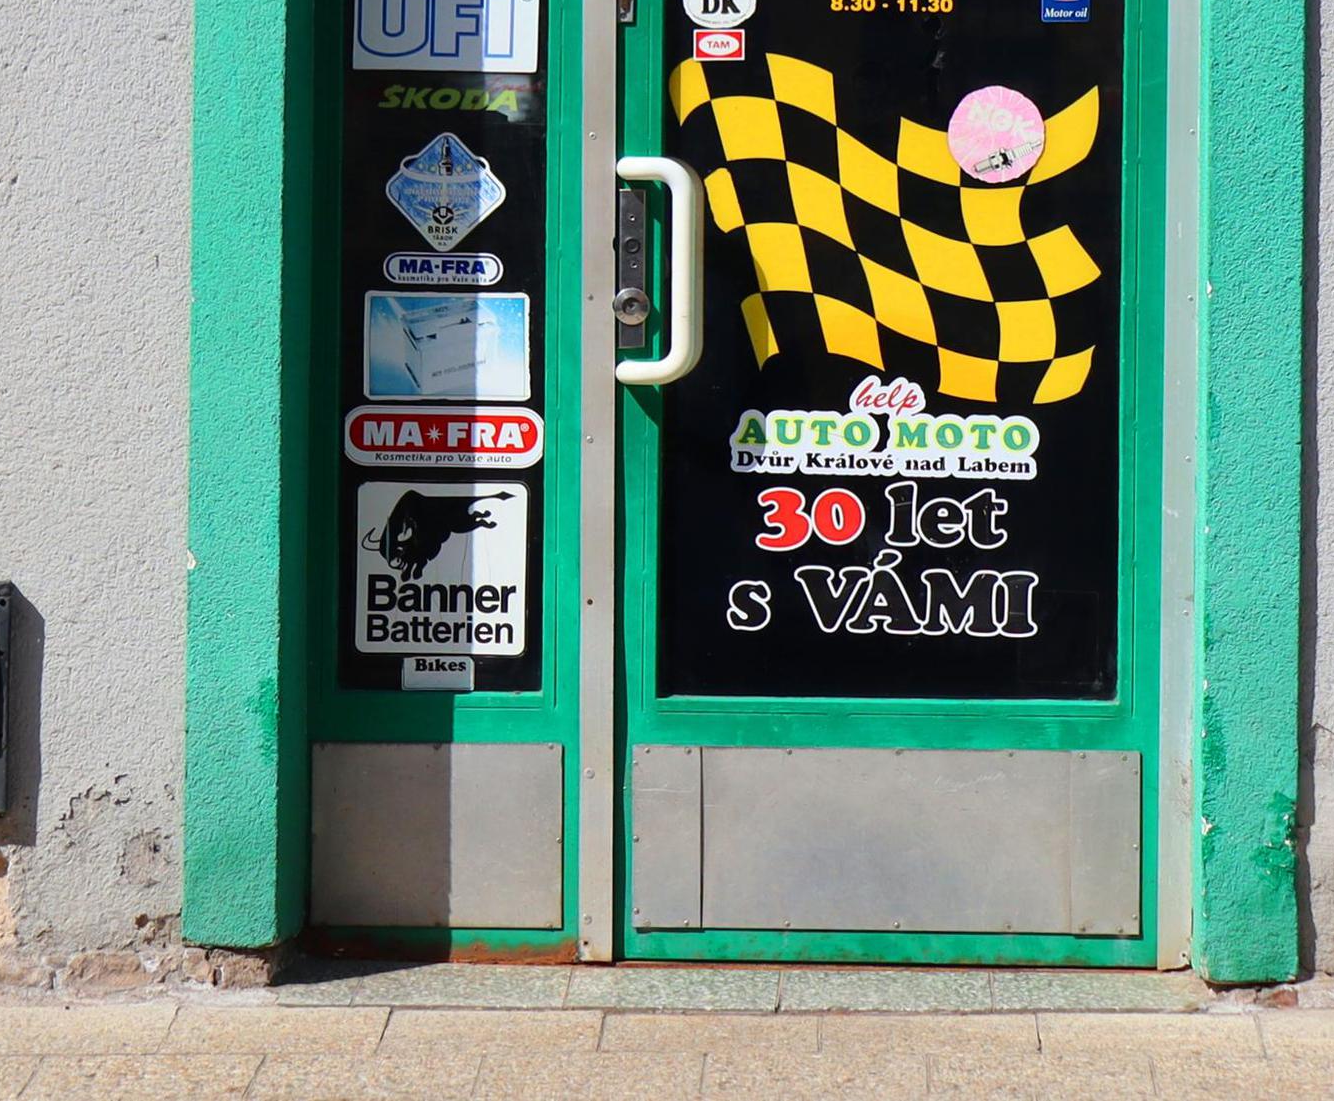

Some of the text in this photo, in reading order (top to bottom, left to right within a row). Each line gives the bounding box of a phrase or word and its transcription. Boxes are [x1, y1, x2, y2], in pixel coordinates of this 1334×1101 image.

[1043, 7, 1089, 19] Motor oil
[707, 40, 731, 49] TAM
[378, 84, 521, 112] ŠKODA
[427, 225, 459, 235] BRISK
[398, 258, 486, 275] MA-FRA
[855, 379, 921, 417] help
[362, 420, 526, 450] MA FRA
[736, 415, 1033, 452] AUTO MOTO
[374, 452, 433, 463] Kosmetika
[435, 454, 454, 464] pro
[486, 454, 512, 464] auto
[736, 450, 1031, 474] Dvůr Králové nad Labem
[756, 480, 1009, 552] 30 let
[366, 572, 517, 615] Banner
[726, 549, 1039, 638] s VÁMI
[365, 614, 515, 647] Batterien
[414, 658, 467, 672] Bikes
